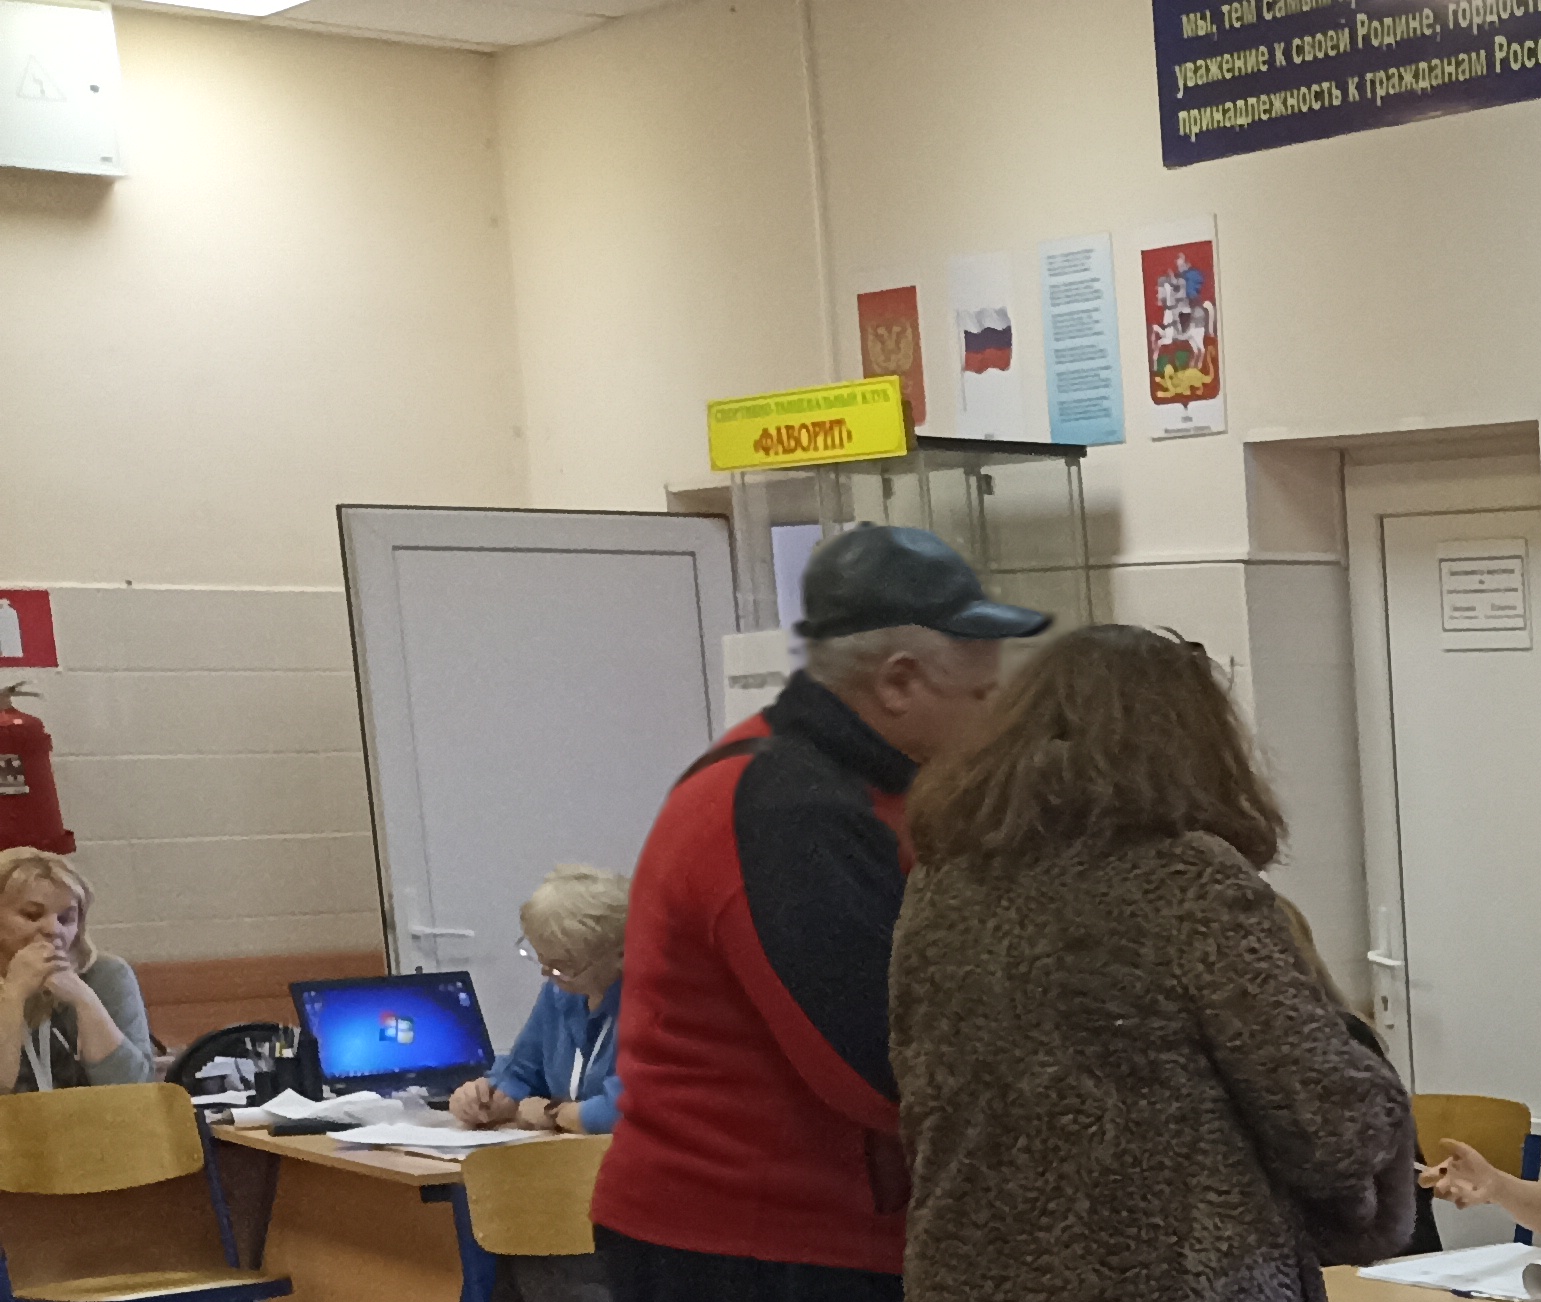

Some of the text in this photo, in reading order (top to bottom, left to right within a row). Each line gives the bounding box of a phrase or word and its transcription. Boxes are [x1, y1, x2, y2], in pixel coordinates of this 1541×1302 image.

[1174, 45, 1269, 98] уважение
[1273, 41, 1287, 67] к
[1291, 18, 1351, 64] своей
[1356, 7, 1441, 49] Родине,
[1221, 0, 1257, 30] тем
[1177, 80, 1342, 142] принадлежность
[1347, 75, 1360, 102] к
[1366, 49, 1488, 107] гражданам
